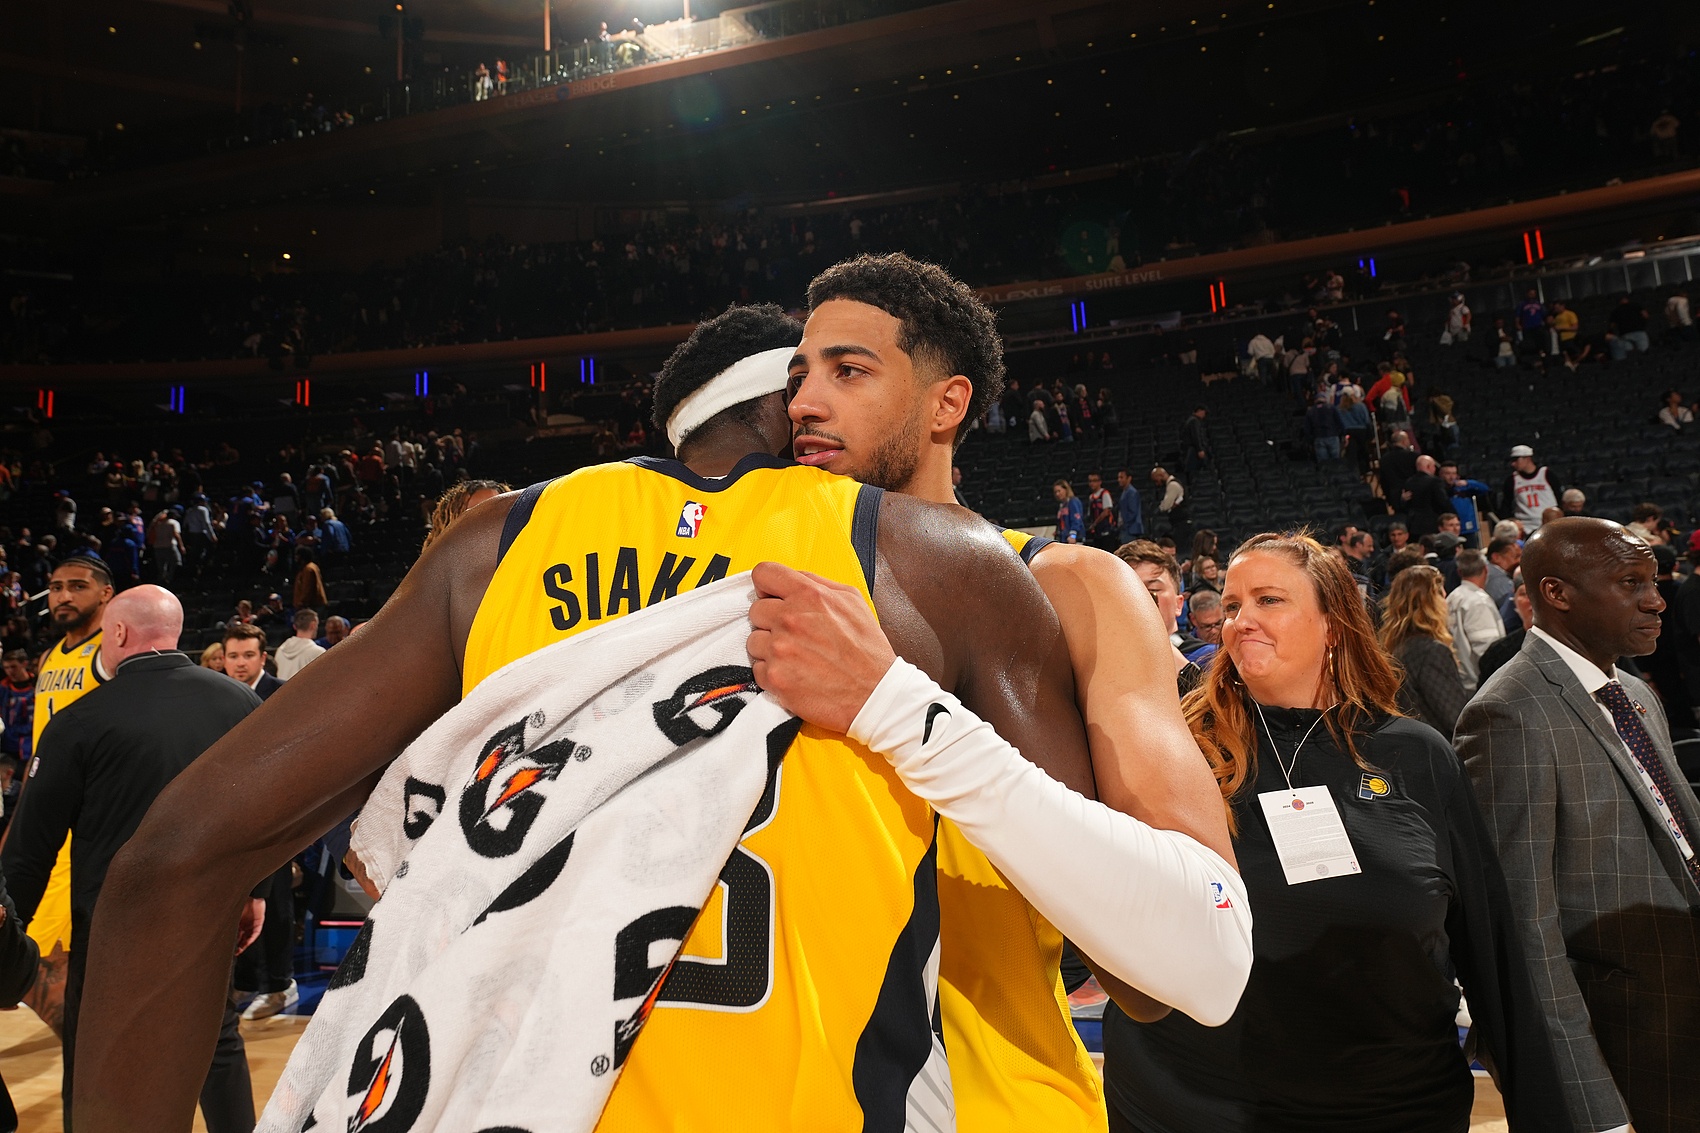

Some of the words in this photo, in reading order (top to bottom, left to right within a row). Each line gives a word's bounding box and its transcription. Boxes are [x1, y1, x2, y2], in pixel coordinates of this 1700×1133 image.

[572, 77, 617, 96] BRIDGE
[1085, 276, 1122, 291] SUITE
[1125, 270, 1163, 285] LEVEL
[995, 285, 1064, 302] LEXUS
[1527, 493, 1540, 508] 11
[677, 526, 691, 536] NBA
